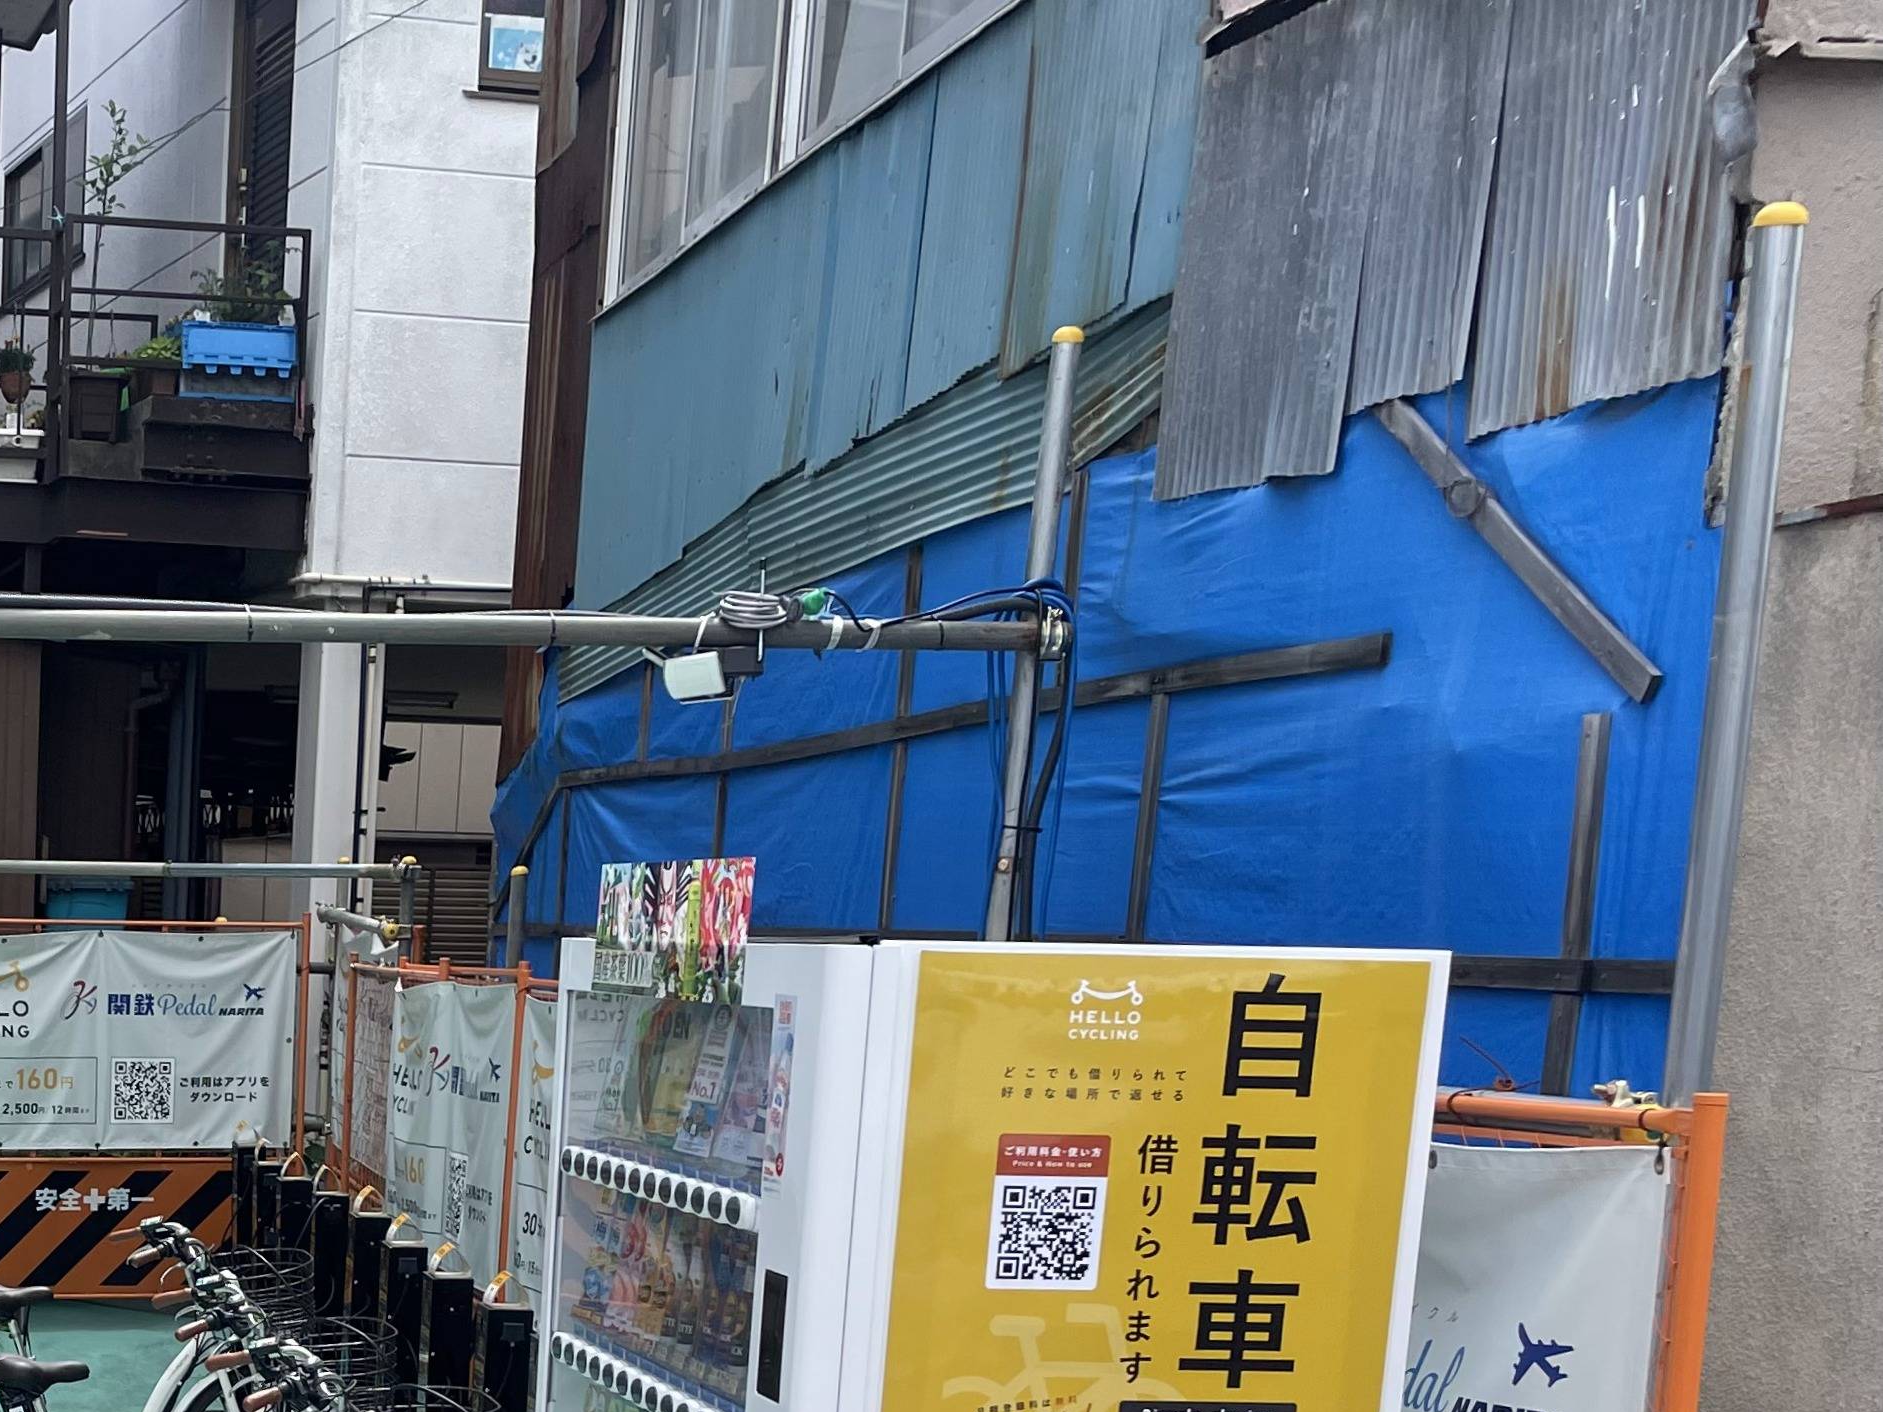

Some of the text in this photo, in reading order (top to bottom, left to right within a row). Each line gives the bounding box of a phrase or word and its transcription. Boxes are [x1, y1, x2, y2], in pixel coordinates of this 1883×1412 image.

[218, 1007, 264, 1016] NARITA
[1069, 1010, 1141, 1025] HELLO
[1068, 1029, 1139, 1041] CYCLING
[1003, 1066, 1187, 1082] どこでも借りられて
[179, 1076, 270, 1089] ご利用はアプリを
[189, 1090, 258, 1102] ダウンロード
[691, 1081, 717, 1100] No.1
[1001, 1086, 1184, 1102] 好きな場所で返せる
[1012, 1160, 1035, 1168] Price
[1178, 973, 1323, 1389] 自転車
[35, 1188, 155, 1212] 安全 第一
[1119, 1133, 1180, 1383] 借りられます
